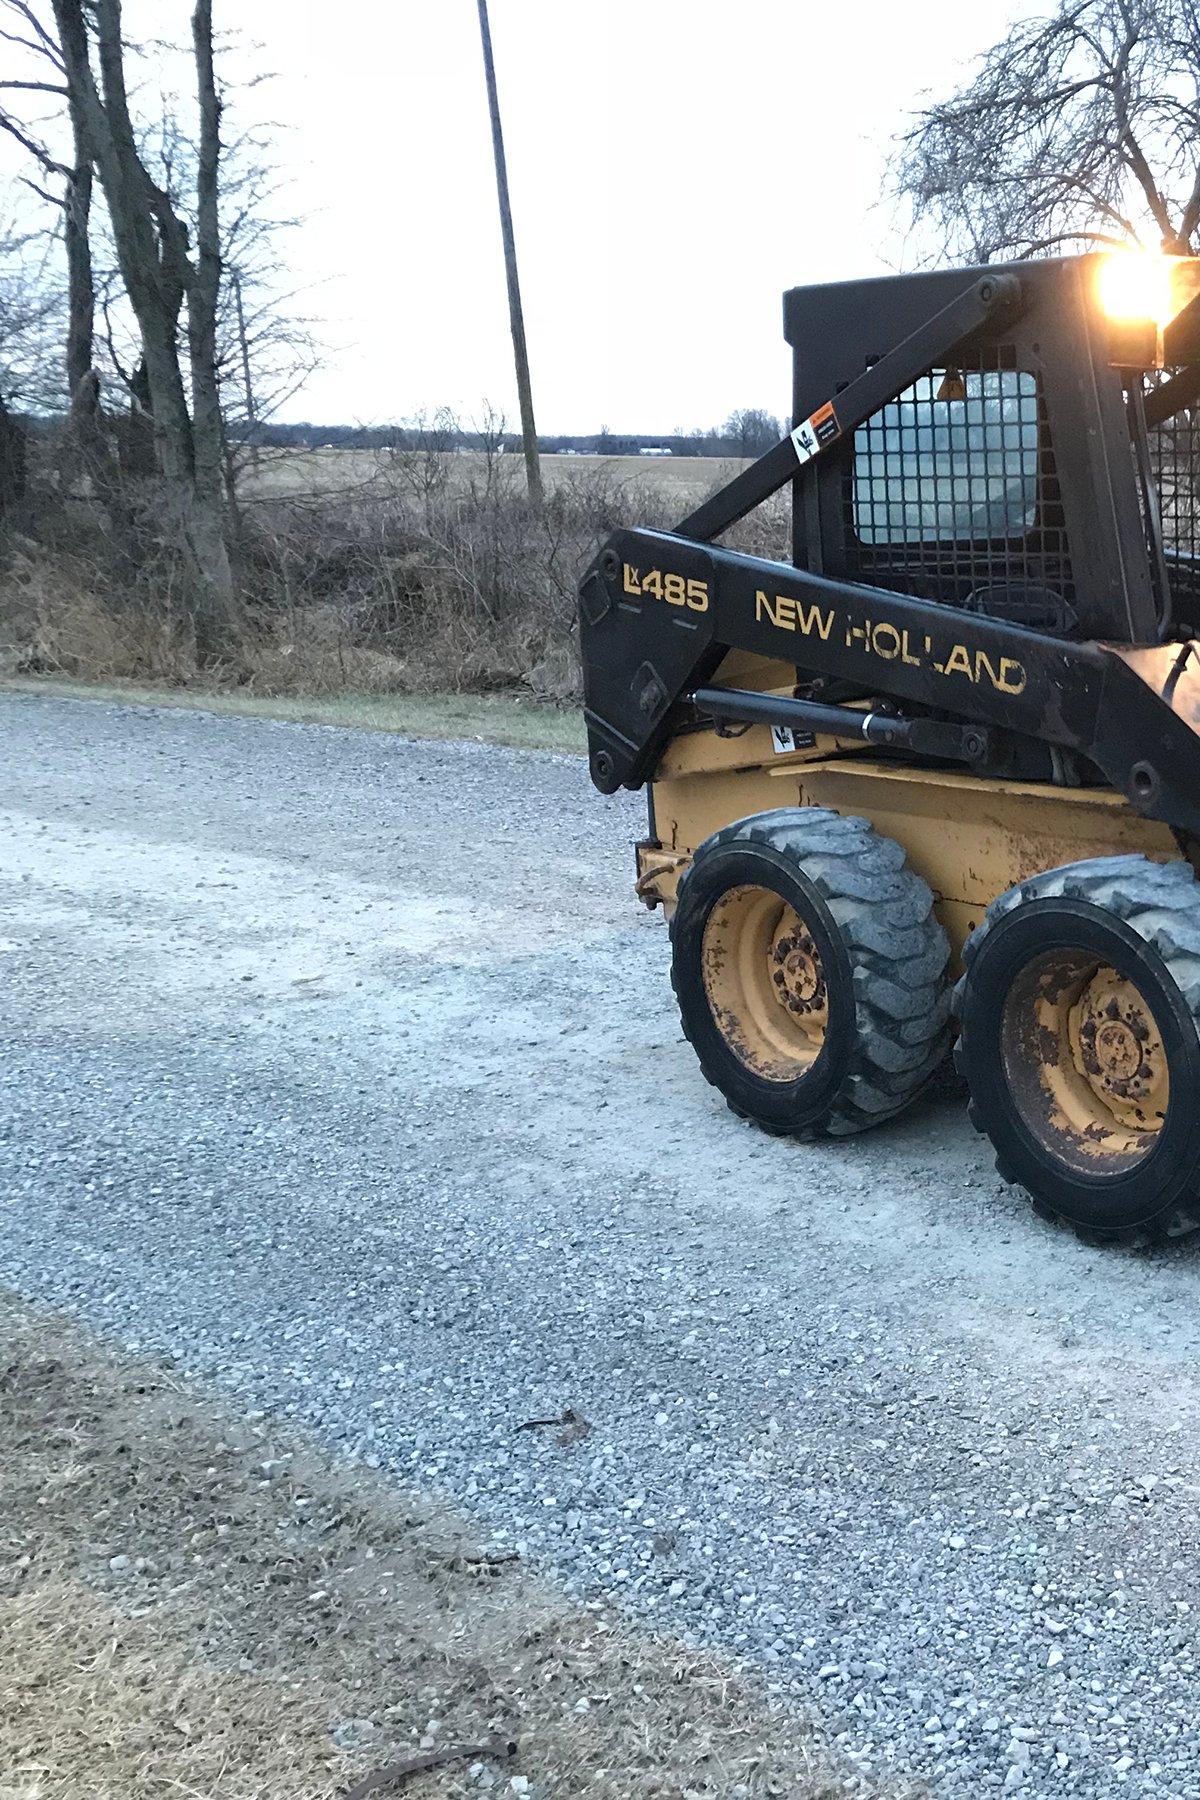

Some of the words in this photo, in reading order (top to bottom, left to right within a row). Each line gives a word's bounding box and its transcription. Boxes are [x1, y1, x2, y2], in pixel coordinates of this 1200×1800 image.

[623, 563, 709, 613] LX485
[755, 590, 836, 641] NEW
[845, 614, 1028, 696] HOLLAND
